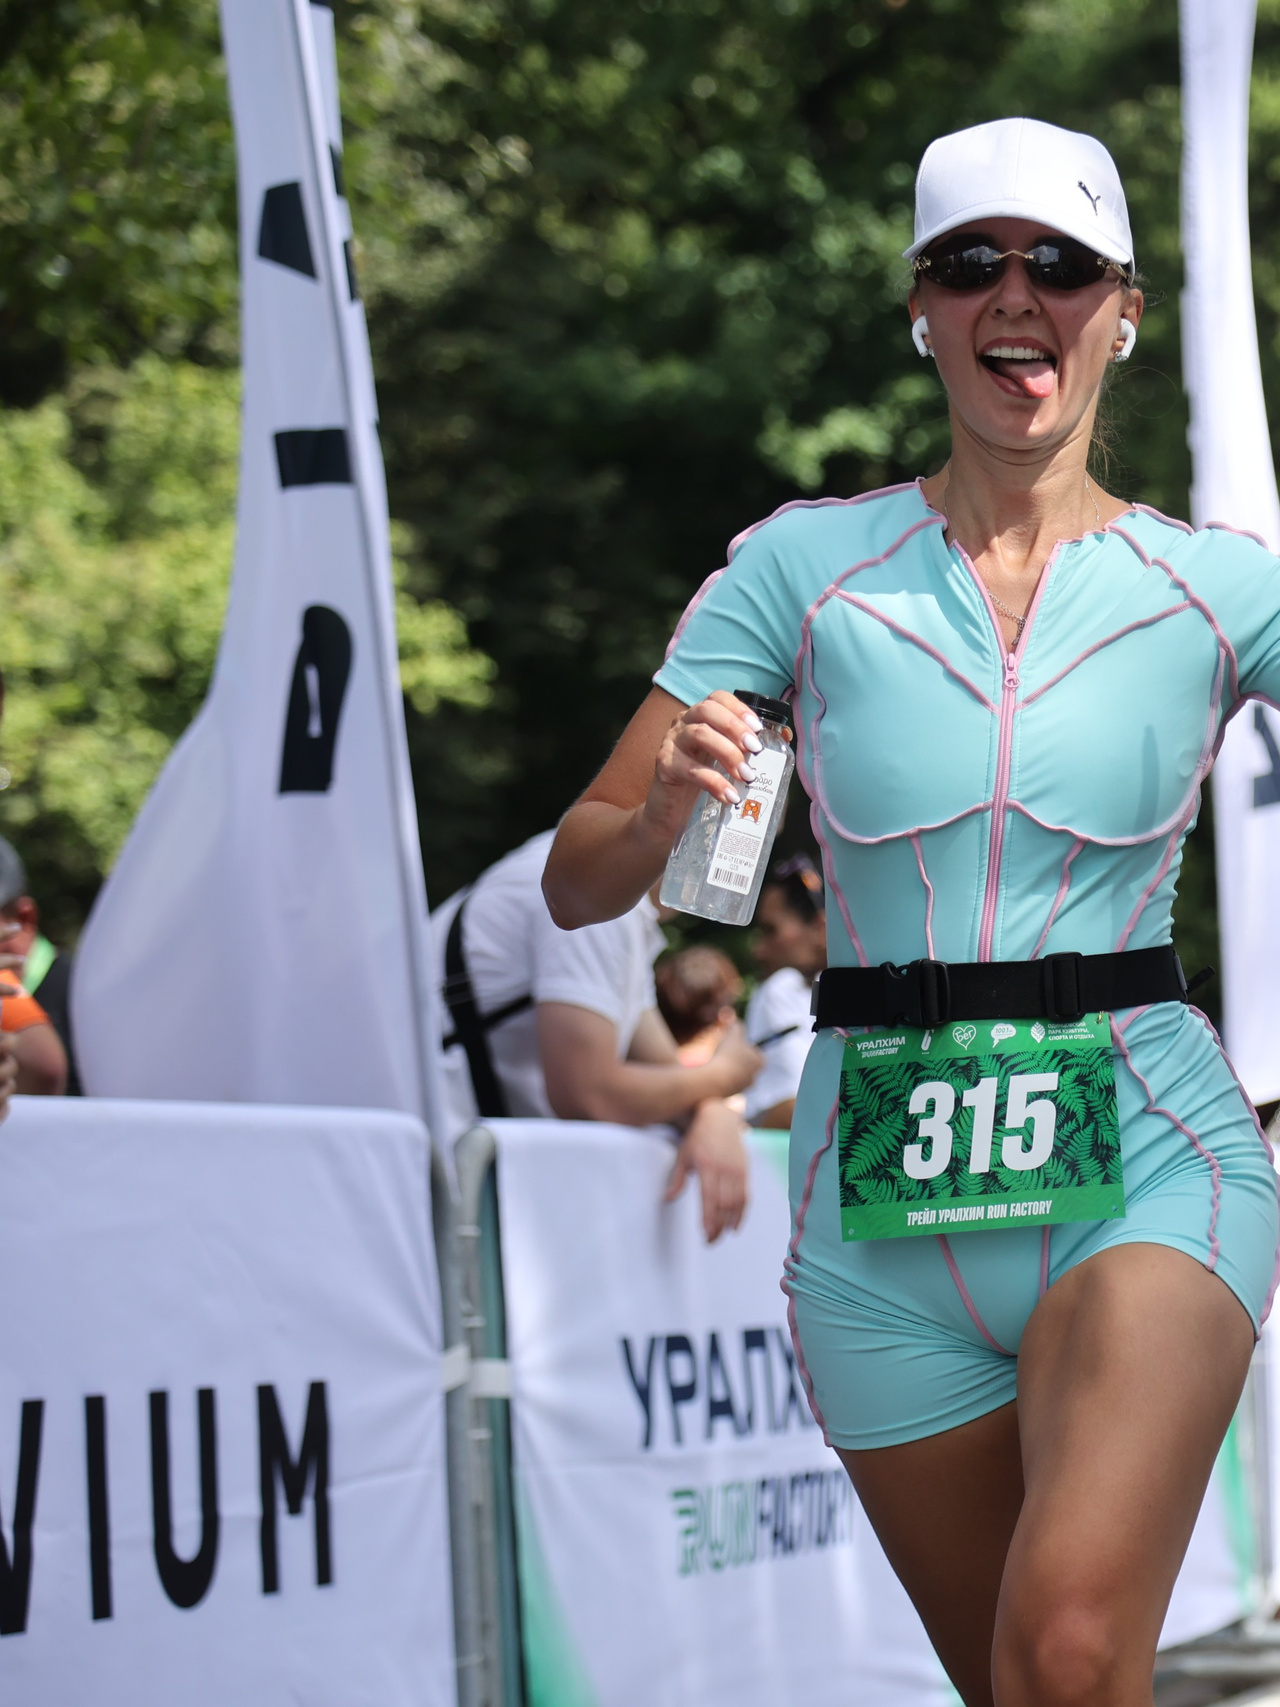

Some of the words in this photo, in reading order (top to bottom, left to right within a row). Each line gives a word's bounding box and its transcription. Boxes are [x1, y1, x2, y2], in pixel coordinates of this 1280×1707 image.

[856, 1036, 906, 1052] УРАЛХИМ
[955, 1029, 974, 1043] Бег
[903, 1072, 1059, 1180] 315
[907, 1208, 937, 1226] ТРЕЙЛ
[937, 1205, 985, 1224] УРАЛХИМ
[987, 1203, 1007, 1219] RUN
[1009, 1200, 1053, 1217] FACTORY
[0, 1378, 334, 1637] VIUM
